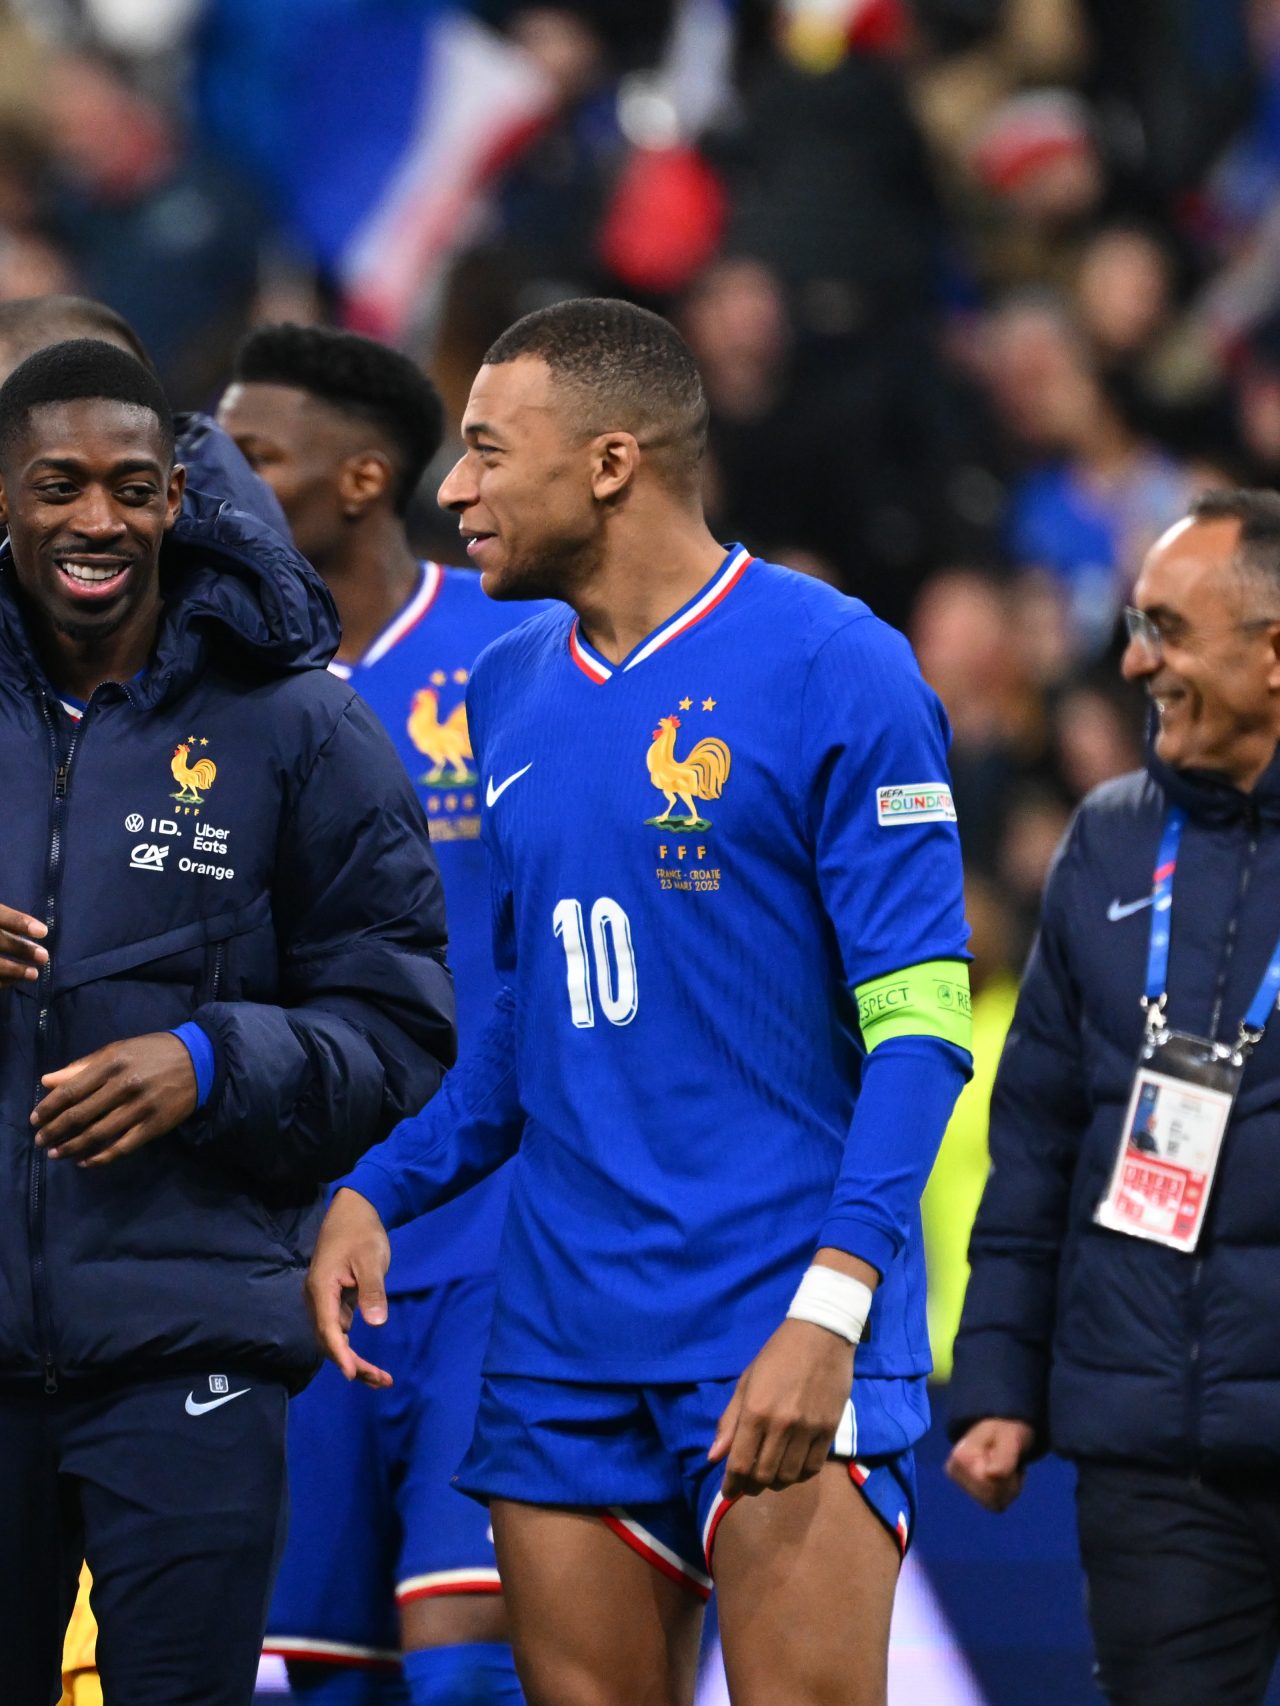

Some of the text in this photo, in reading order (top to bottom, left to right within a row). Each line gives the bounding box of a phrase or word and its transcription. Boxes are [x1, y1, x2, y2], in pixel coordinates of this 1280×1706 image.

[880, 788, 904, 798] UEFA
[195, 822, 230, 840] Uber
[193, 836, 228, 855] Eats
[178, 857, 235, 880] Orange
[656, 868, 681, 879] FRANCE
[690, 869, 721, 880] CROATIE
[661, 879, 720, 892] 23 MARS 2025
[552, 896, 639, 1029] 10
[860, 987, 910, 1022] SPECT
